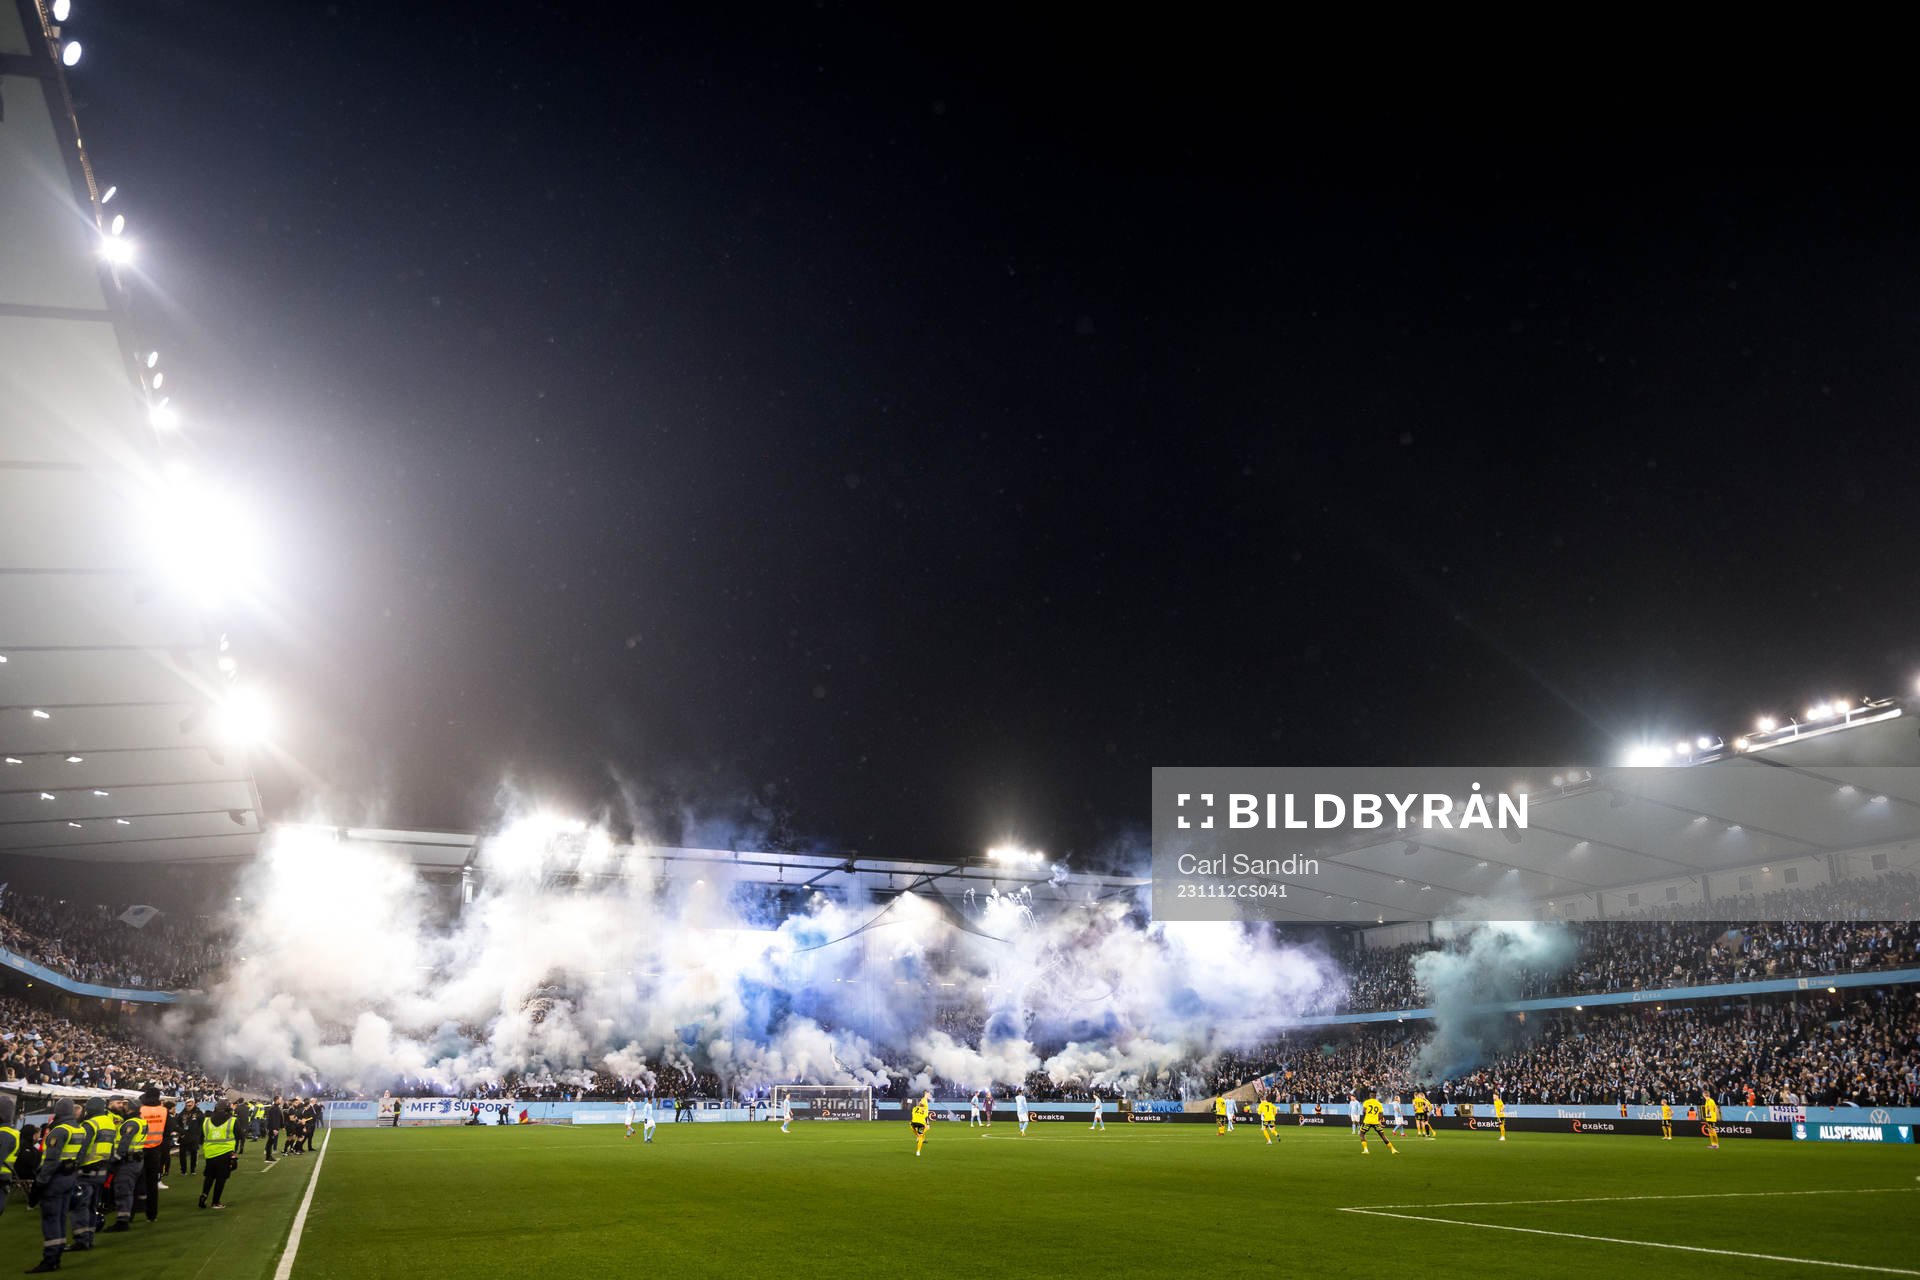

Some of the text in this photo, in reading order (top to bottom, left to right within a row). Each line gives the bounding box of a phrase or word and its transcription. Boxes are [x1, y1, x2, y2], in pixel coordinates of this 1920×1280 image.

[410, 1102, 436, 1113] MFF
[1368, 1104, 1379, 1115] 29
[1037, 1113, 1065, 1121] exakta
[1582, 1121, 1615, 1131] exakta
[1819, 1125, 1884, 1141] ALLSVENSKAN
